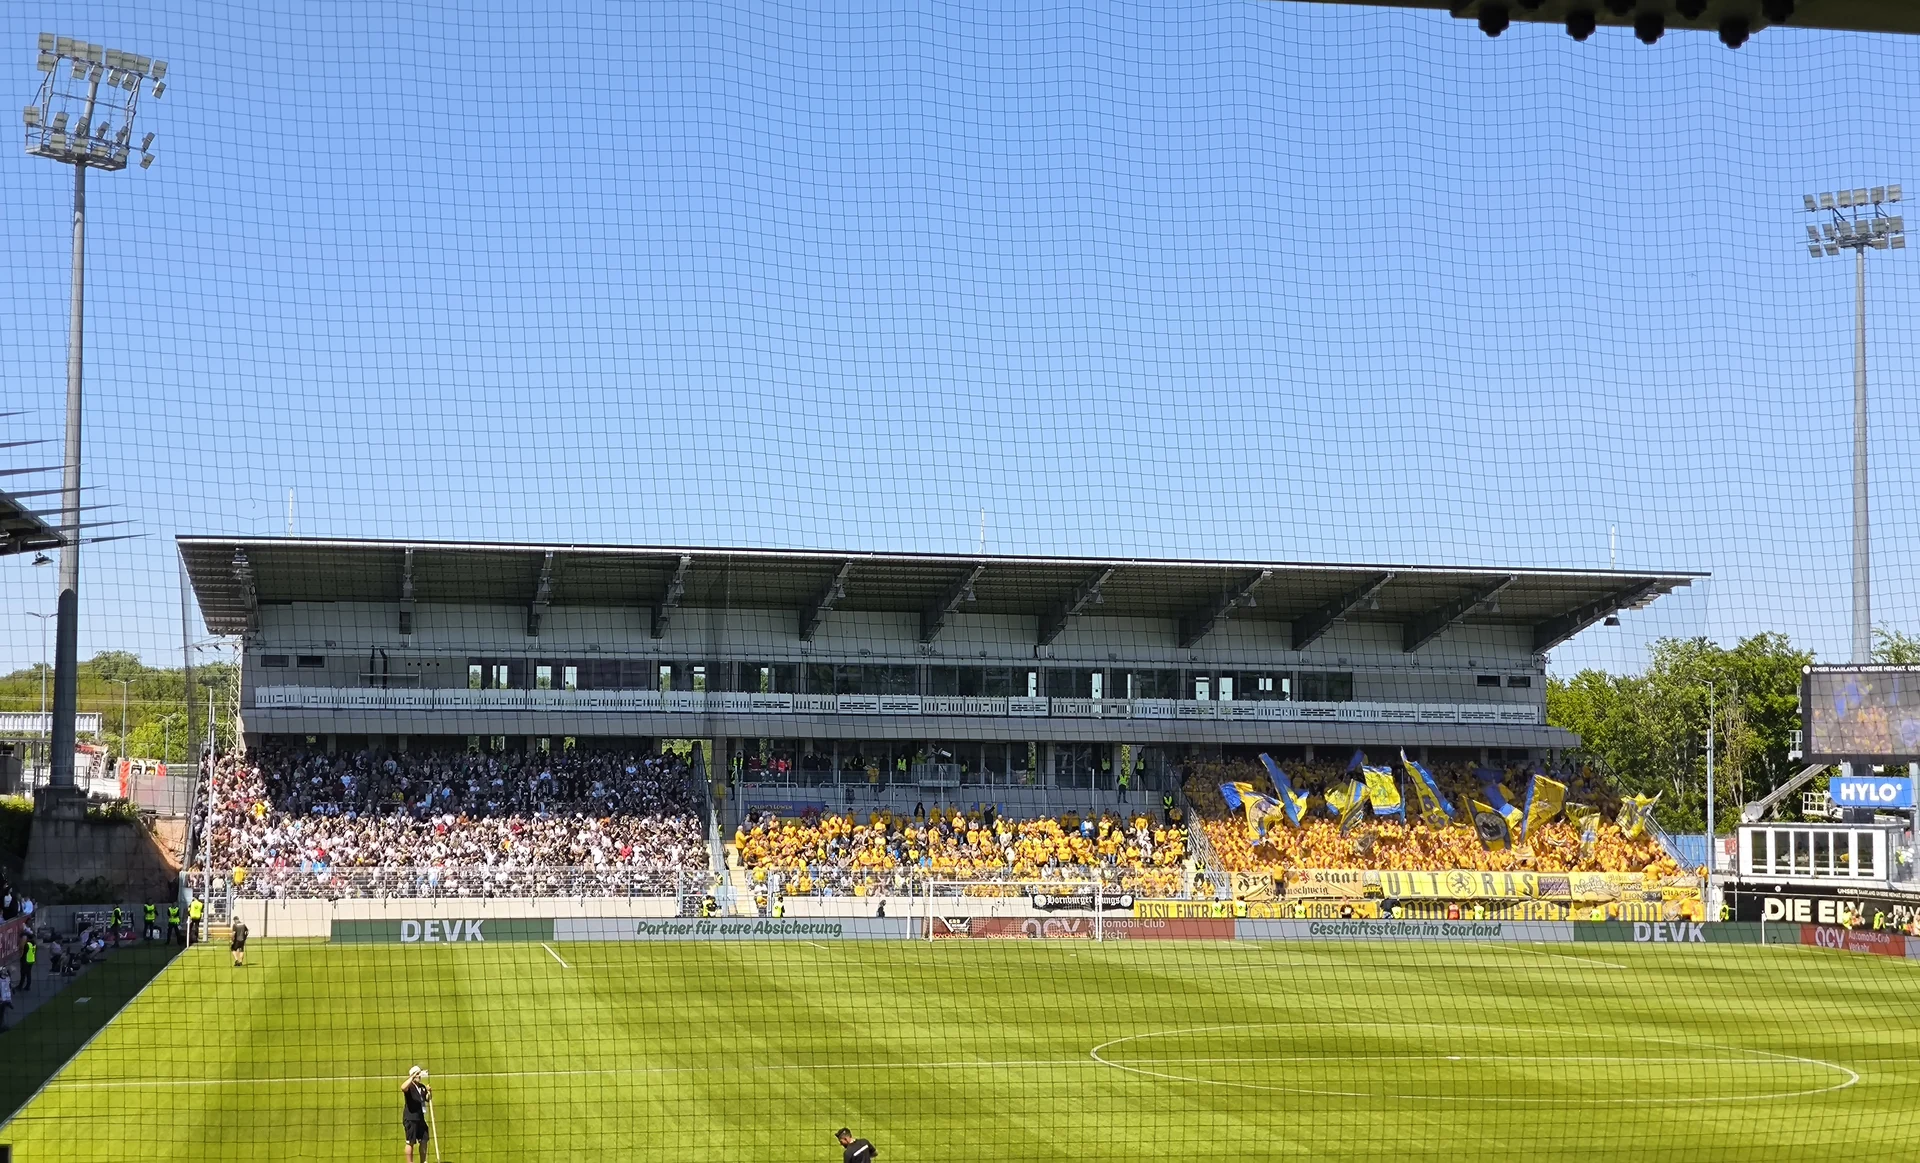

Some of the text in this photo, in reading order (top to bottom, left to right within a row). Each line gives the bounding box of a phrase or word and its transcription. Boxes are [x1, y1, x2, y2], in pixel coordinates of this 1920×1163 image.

[1310, 904, 1339, 918] 1895
[1764, 897, 1811, 923] DIE
[401, 919, 485, 942] DEVK
[637, 920, 842, 937] Partner für eure Absicherung
[1088, 919, 1165, 928] Atomobil-Club
[1310, 921, 1501, 937] Geschäftsstellen im Saarland
[1088, 930, 1127, 939] Vrkehr
[1633, 922, 1706, 942] DEVK
